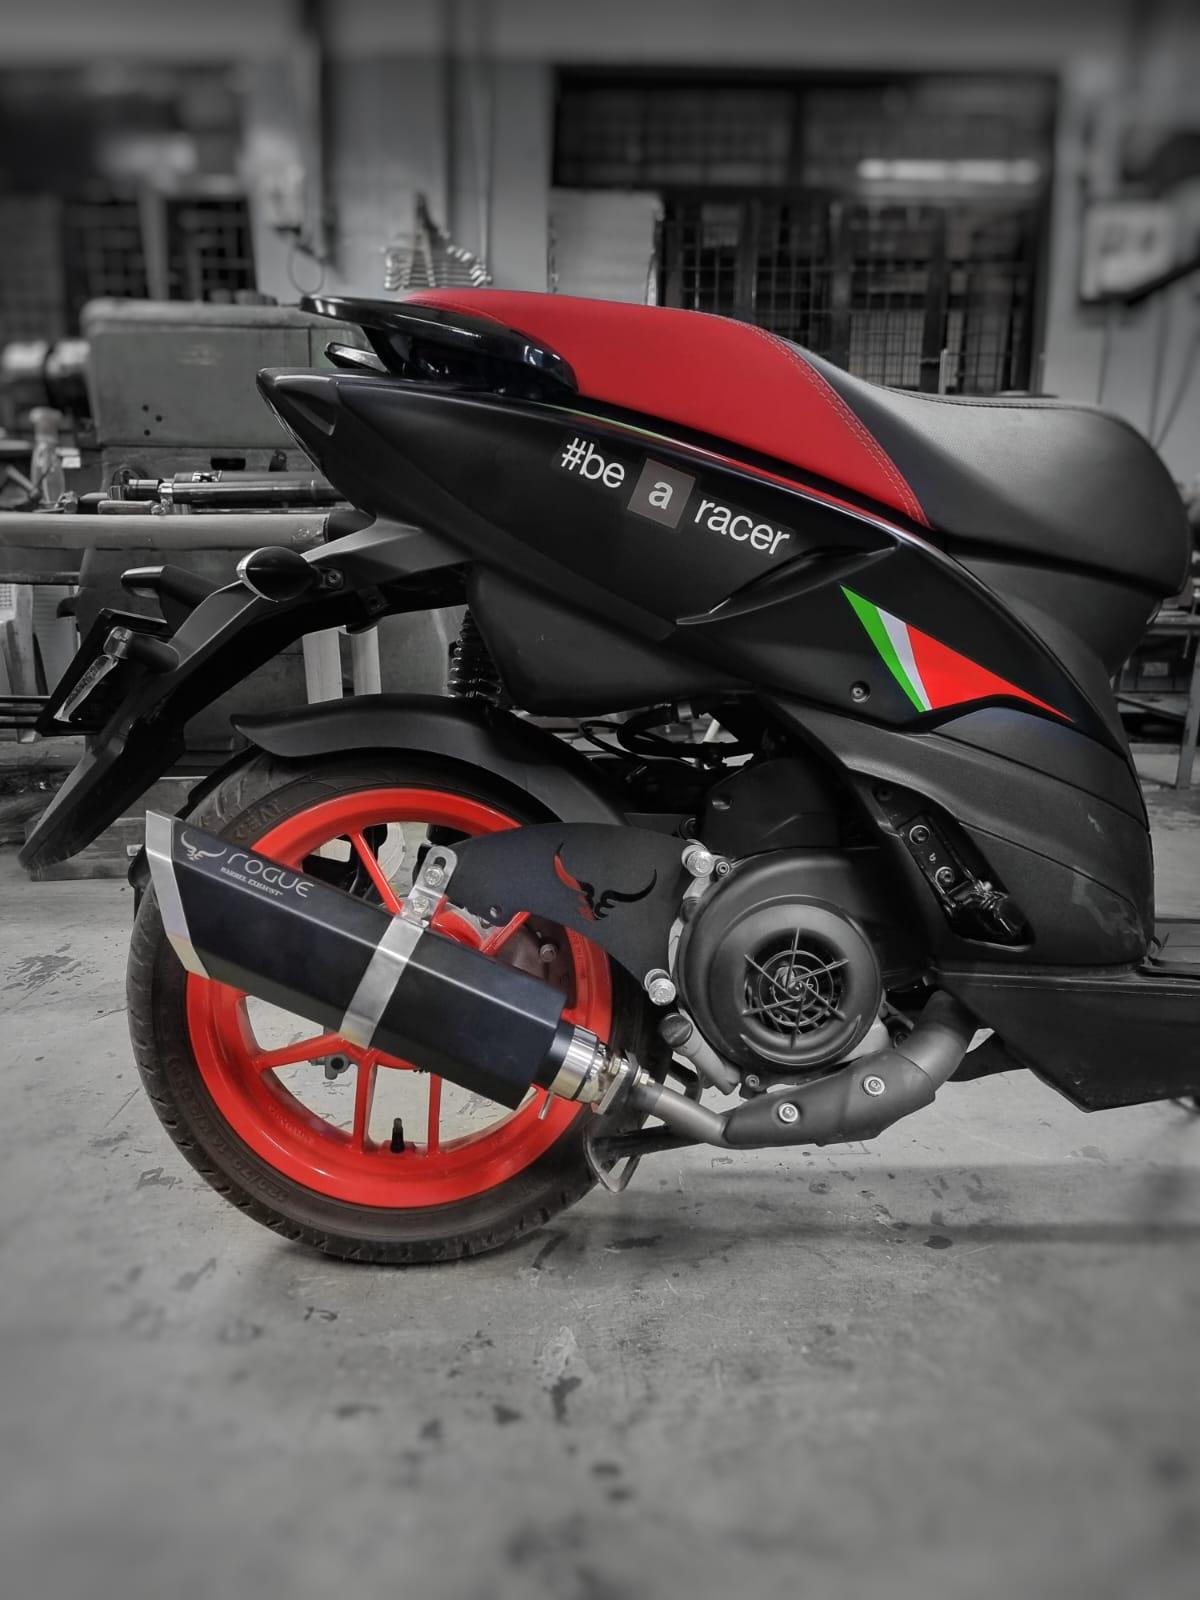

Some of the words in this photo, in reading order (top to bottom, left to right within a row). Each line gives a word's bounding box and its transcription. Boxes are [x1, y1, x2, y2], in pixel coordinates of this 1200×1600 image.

[561, 437, 625, 488] #be
[648, 481, 674, 510] a
[694, 499, 790, 555] racer
